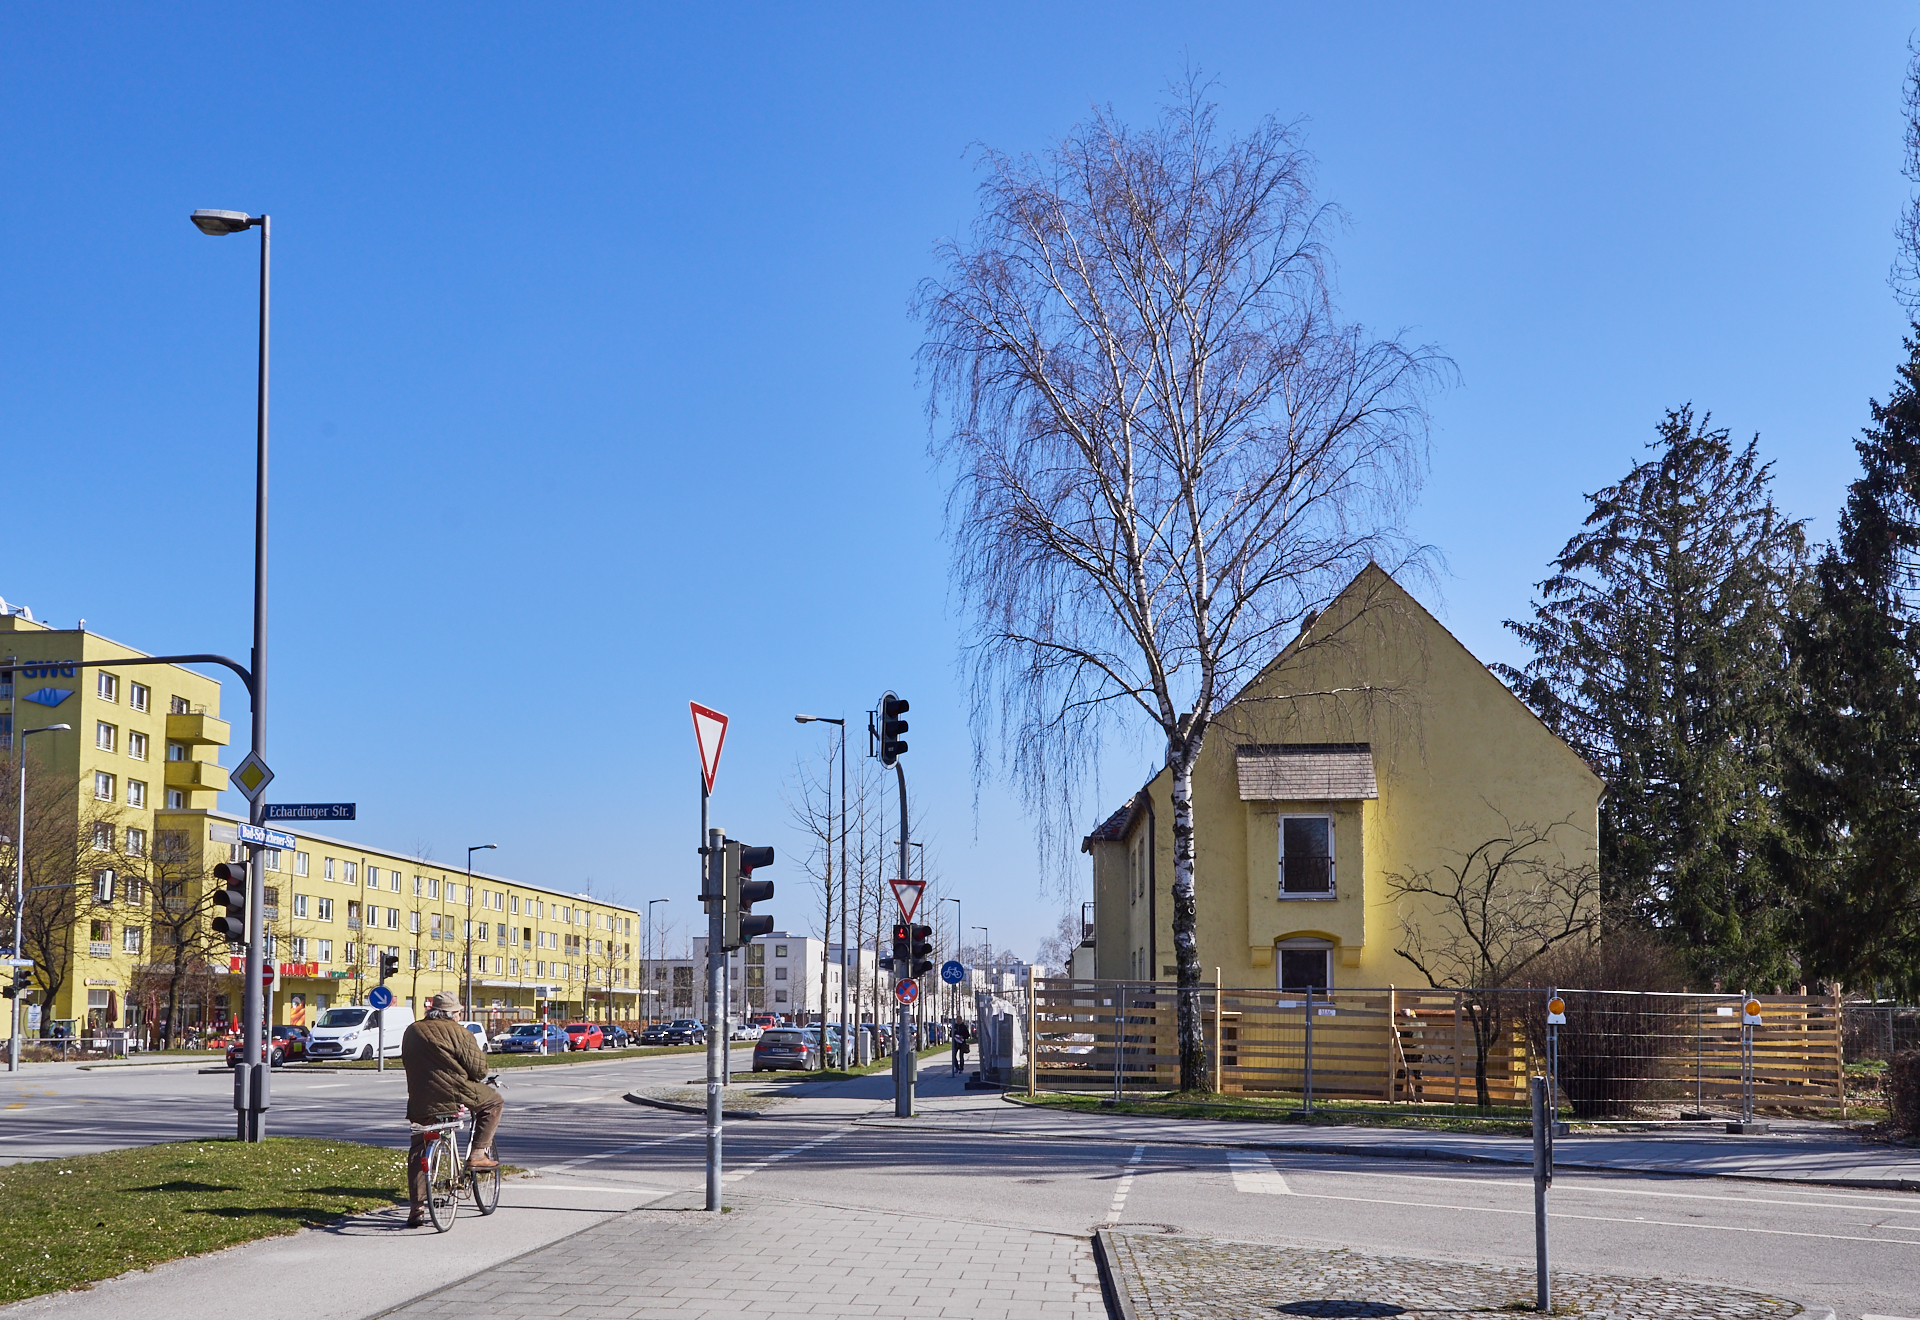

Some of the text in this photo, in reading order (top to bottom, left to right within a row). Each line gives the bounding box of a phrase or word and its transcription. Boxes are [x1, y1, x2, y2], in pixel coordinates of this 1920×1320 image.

[22, 660, 75, 678] GWG
[269, 805, 349, 818] Echardinger Str.
